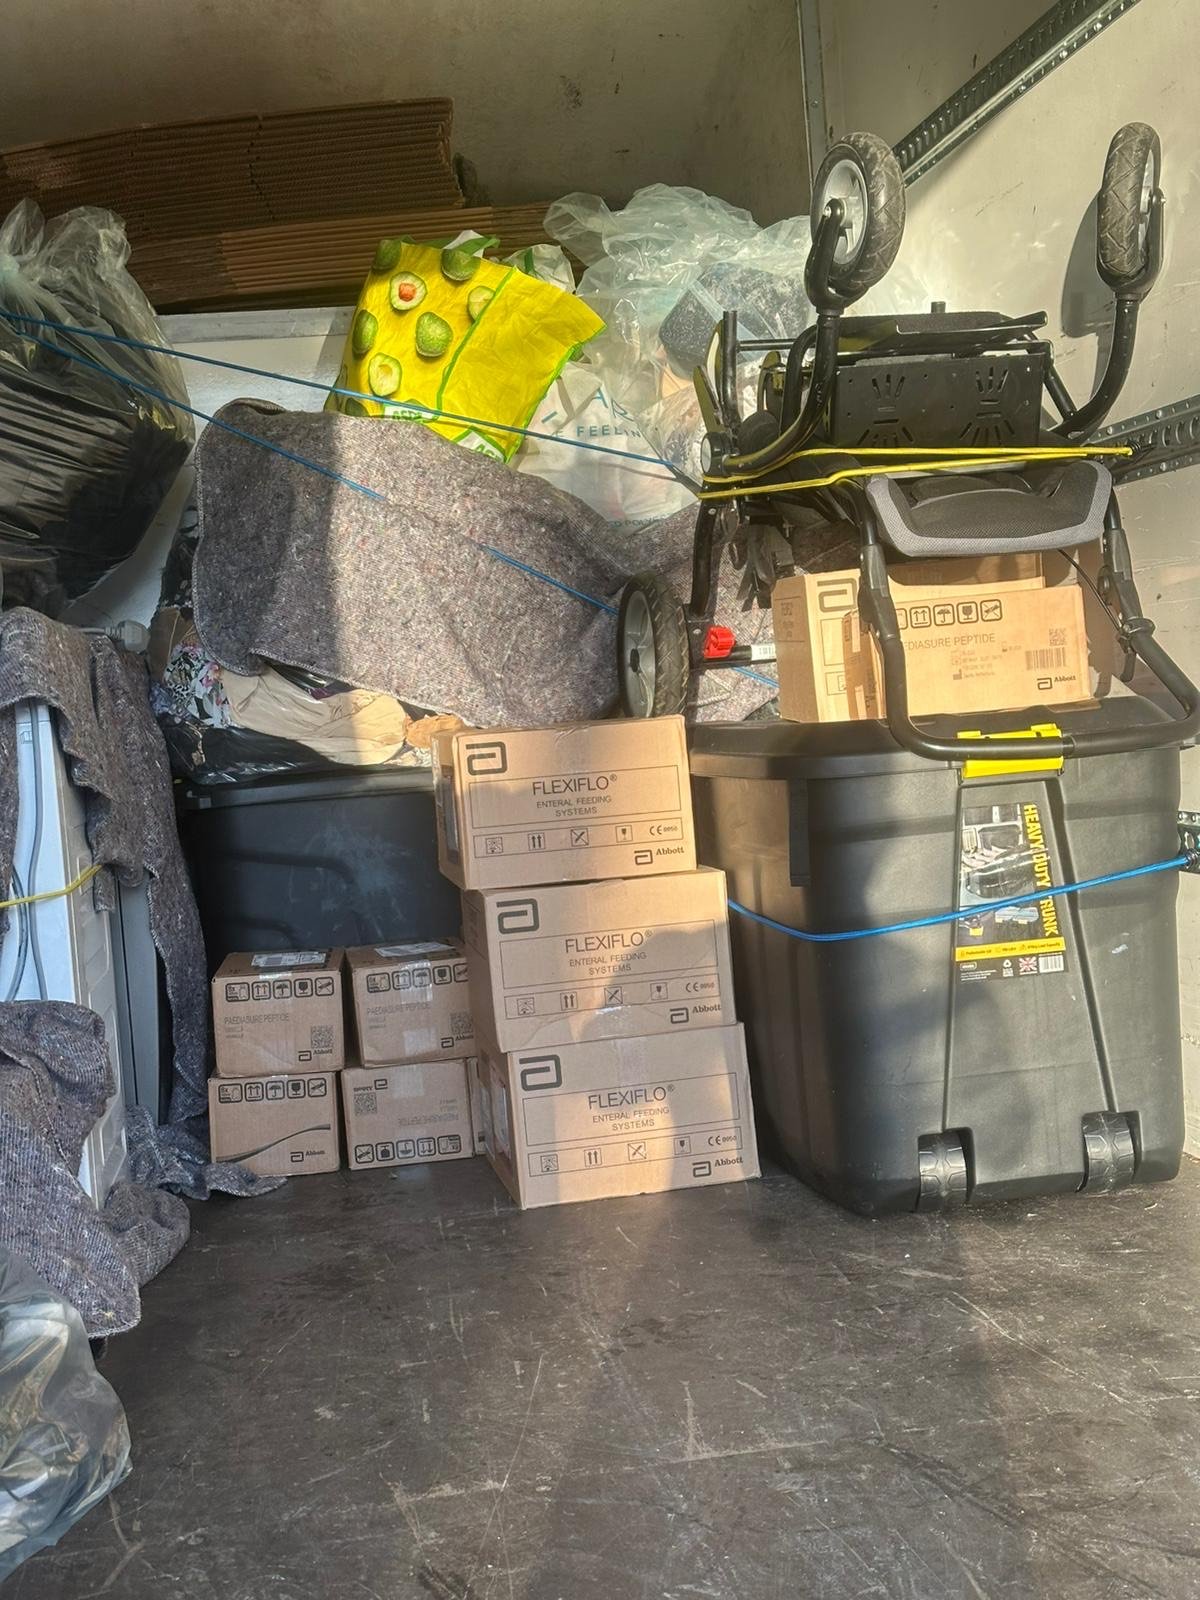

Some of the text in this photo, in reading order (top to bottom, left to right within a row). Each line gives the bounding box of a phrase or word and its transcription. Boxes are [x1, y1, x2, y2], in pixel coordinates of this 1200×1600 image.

[576, 425, 641, 438] FEELIN
[954, 633, 996, 646] PEPTIDE
[1054, 674, 1077, 683] Abbott
[536, 794, 612, 809] ENTERAL FEEDING
[555, 806, 598, 818] SYSTEMS
[656, 846, 685, 856] Abbott
[1023, 803, 1060, 937] HEAVY DUTY RUNK
[569, 951, 648, 968] ENTERAL FEEDING
[588, 963, 632, 976] SYSTEMS
[692, 1003, 722, 1014] Abbott
[592, 1106, 670, 1124] ENTERAL FEEDING
[612, 1118, 655, 1132] SYSTEMS
[714, 1156, 744, 1167] Abbott
